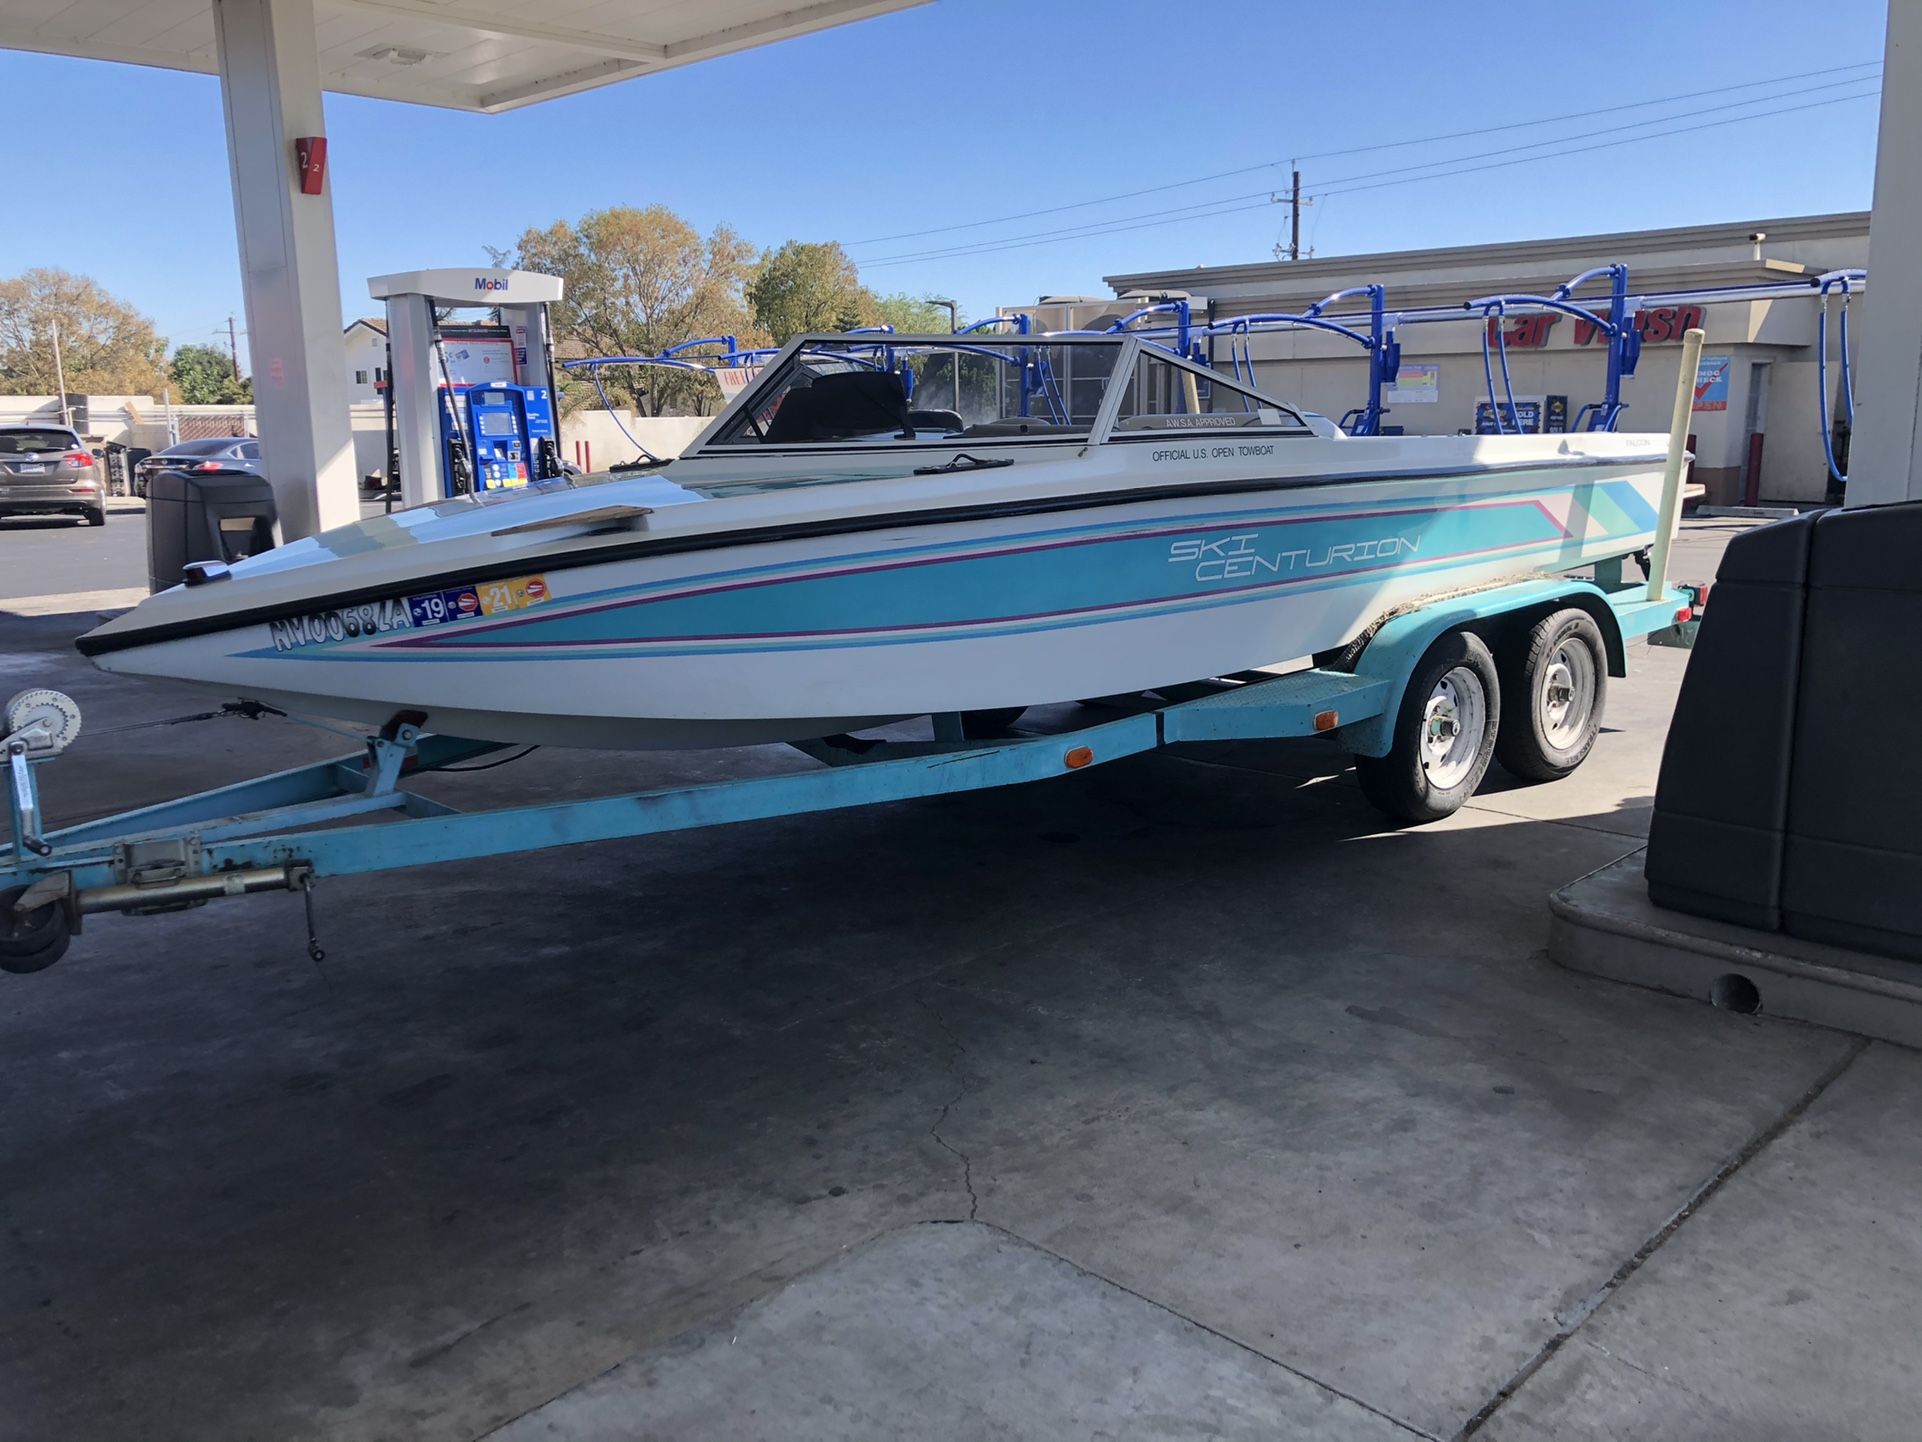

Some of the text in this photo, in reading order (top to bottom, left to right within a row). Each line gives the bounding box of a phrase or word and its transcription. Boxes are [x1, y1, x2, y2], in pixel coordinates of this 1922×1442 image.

[300, 151, 308, 169] 2
[312, 163, 320, 173] 2
[474, 277, 509, 291] Mobil
[541, 390, 548, 400] 2
[1196, 415, 1236, 427] APPROVED
[1152, 445, 1275, 462] OFFICIAL U.S. OPEN TOWBOAT
[1168, 533, 1259, 562] SKI
[1195, 535, 1421, 581] CENTURION
[488, 584, 513, 607] 21
[421, 597, 445, 619] 19
